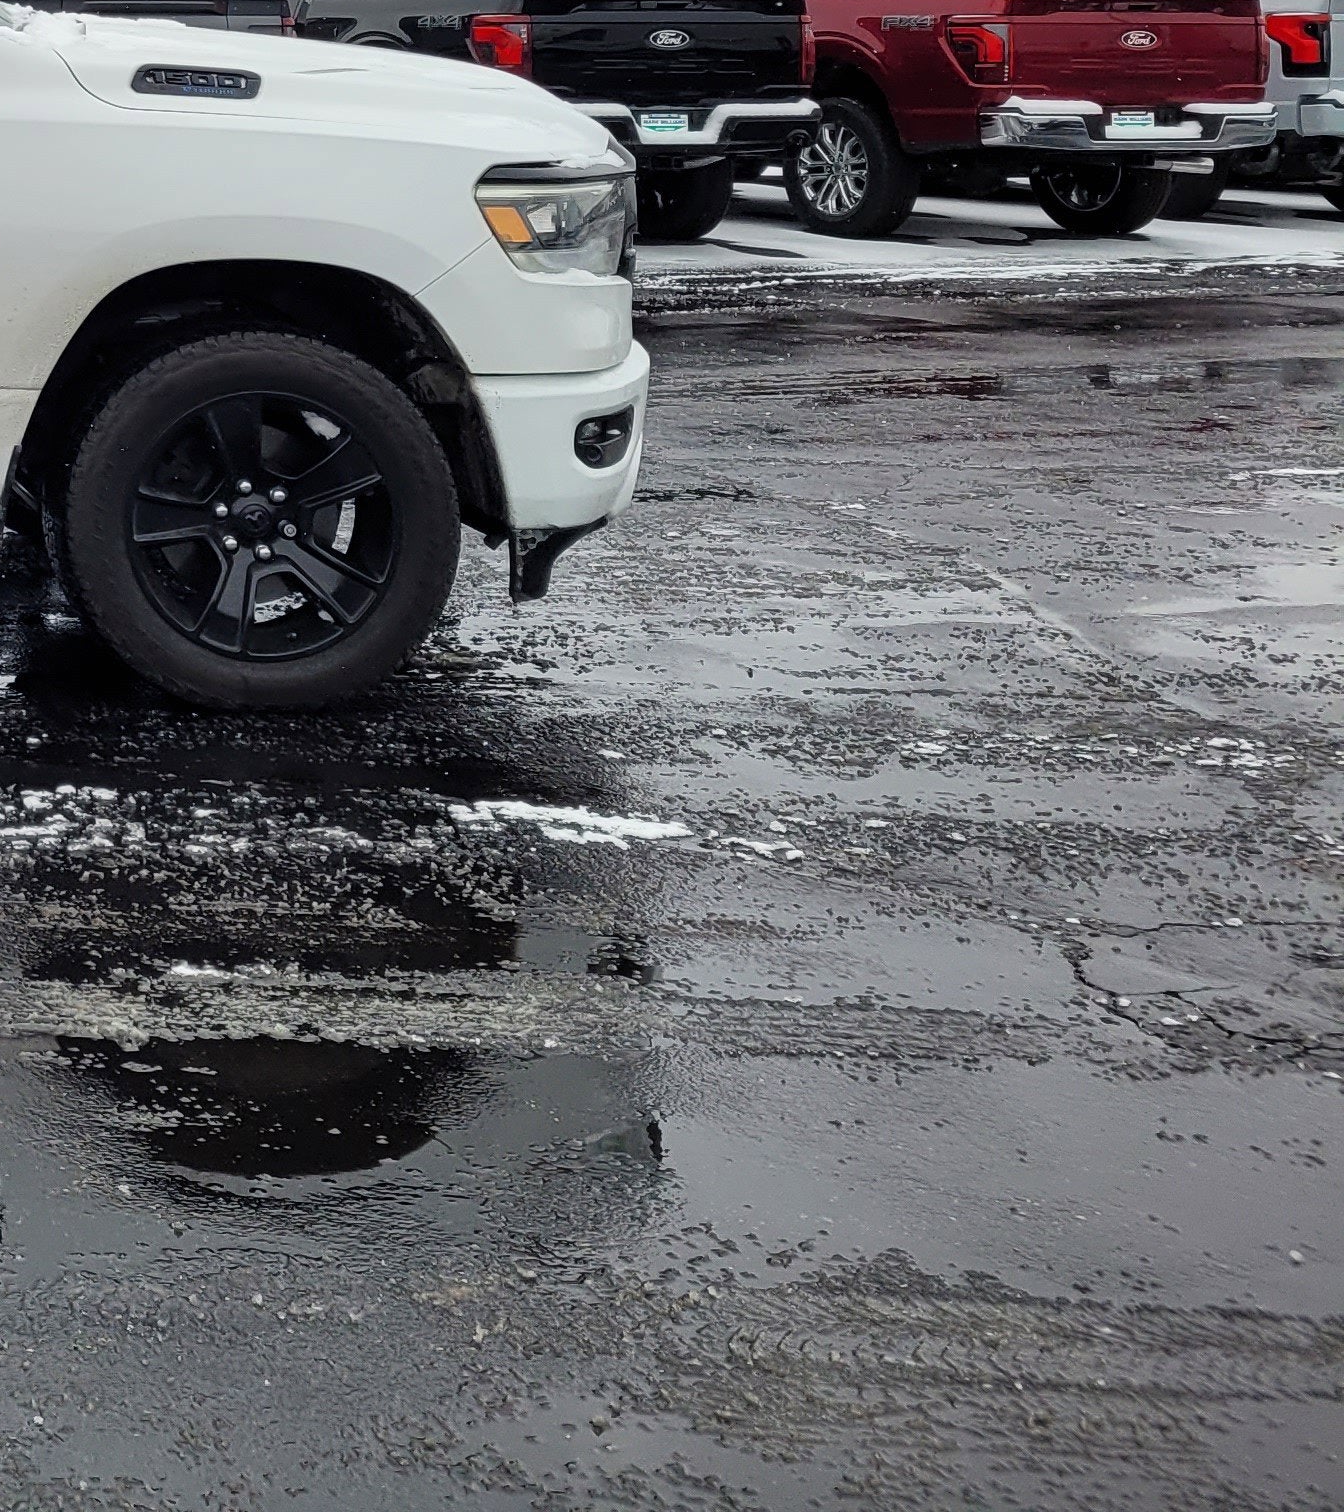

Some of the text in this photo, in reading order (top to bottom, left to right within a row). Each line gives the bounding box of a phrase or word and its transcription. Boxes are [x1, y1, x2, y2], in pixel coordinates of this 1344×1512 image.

[656, 32, 683, 45] Ford
[1127, 33, 1152, 45] Ford
[144, 68, 248, 89] 1500
